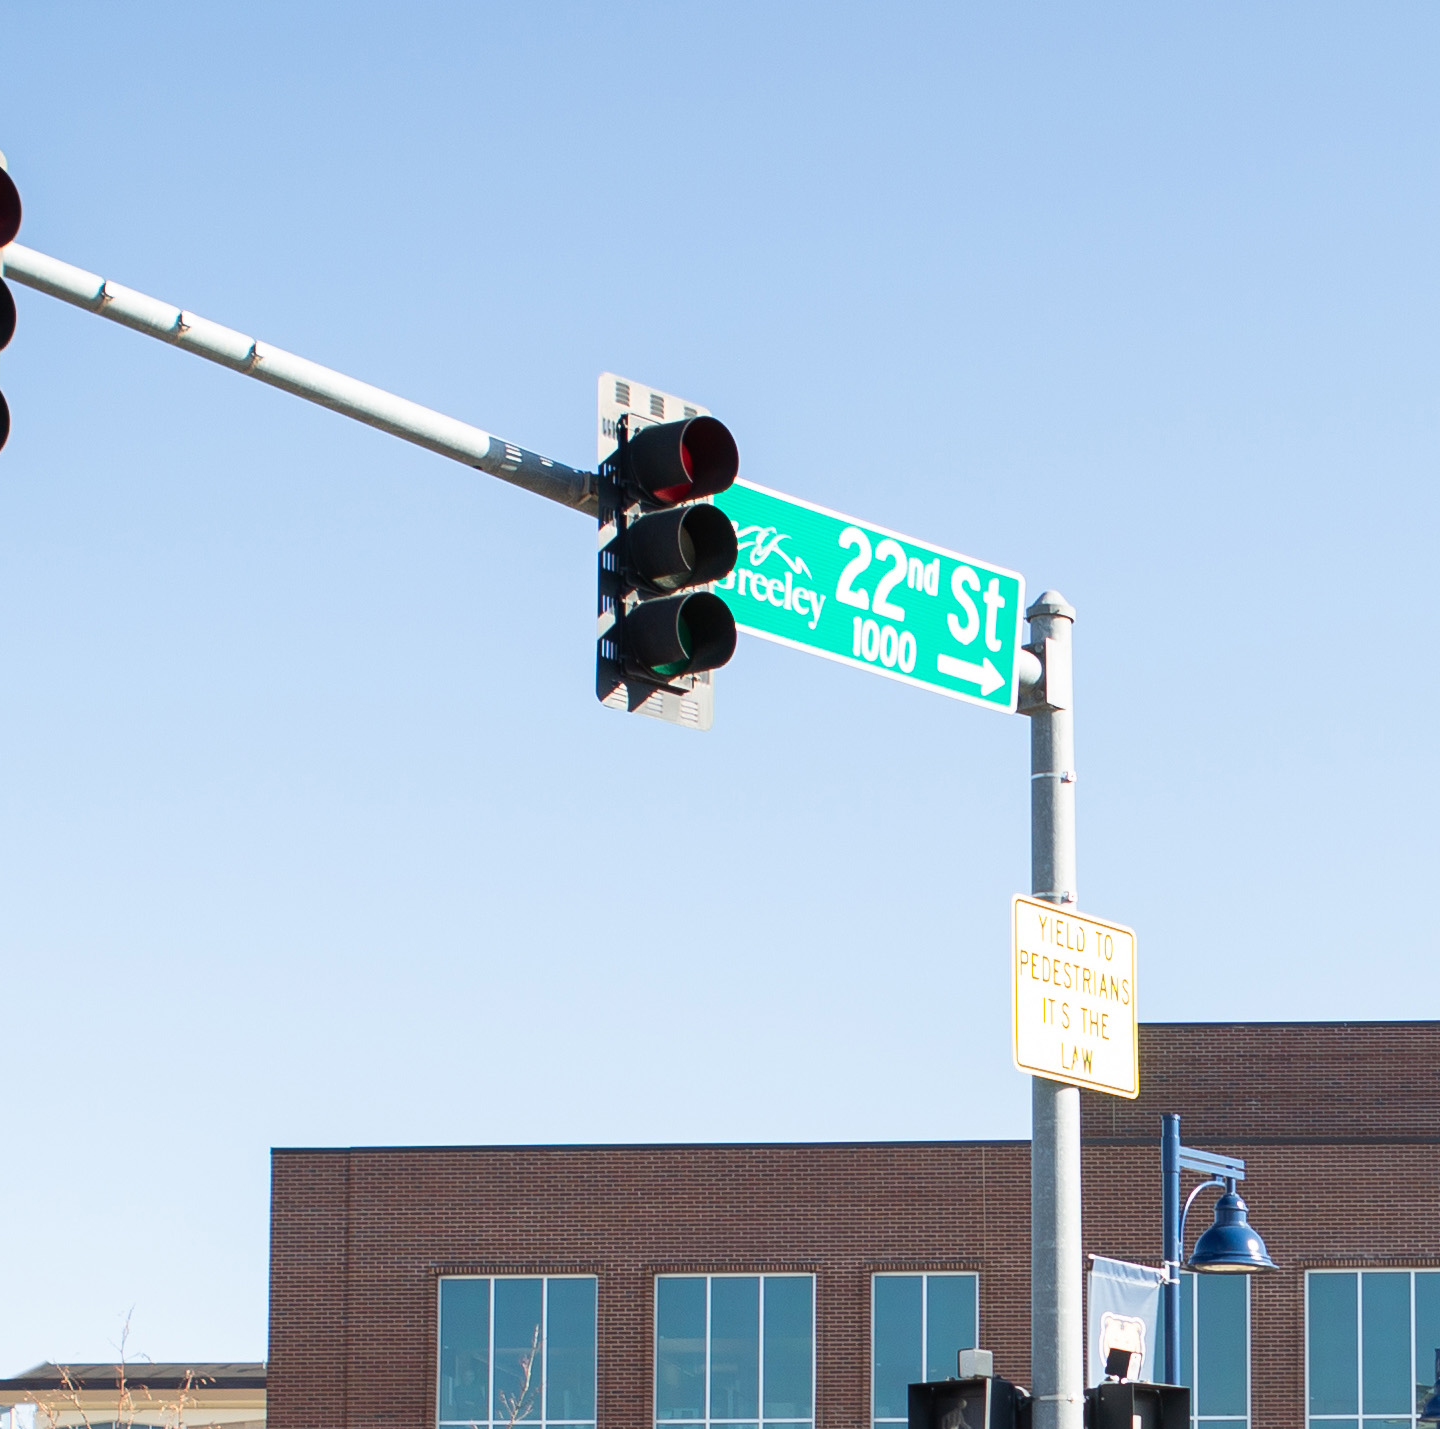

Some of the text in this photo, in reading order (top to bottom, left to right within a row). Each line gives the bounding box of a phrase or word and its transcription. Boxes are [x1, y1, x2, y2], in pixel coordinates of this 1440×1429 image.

[835, 525, 1006, 652] 22nd St
[852, 616, 918, 674] 1000
[1038, 913, 1114, 961] YIELD TO
[1019, 949, 1131, 1006] PEDESTRIANS
[1080, 1007, 1110, 1041] THE
[1061, 1042, 1094, 1075] LAW
